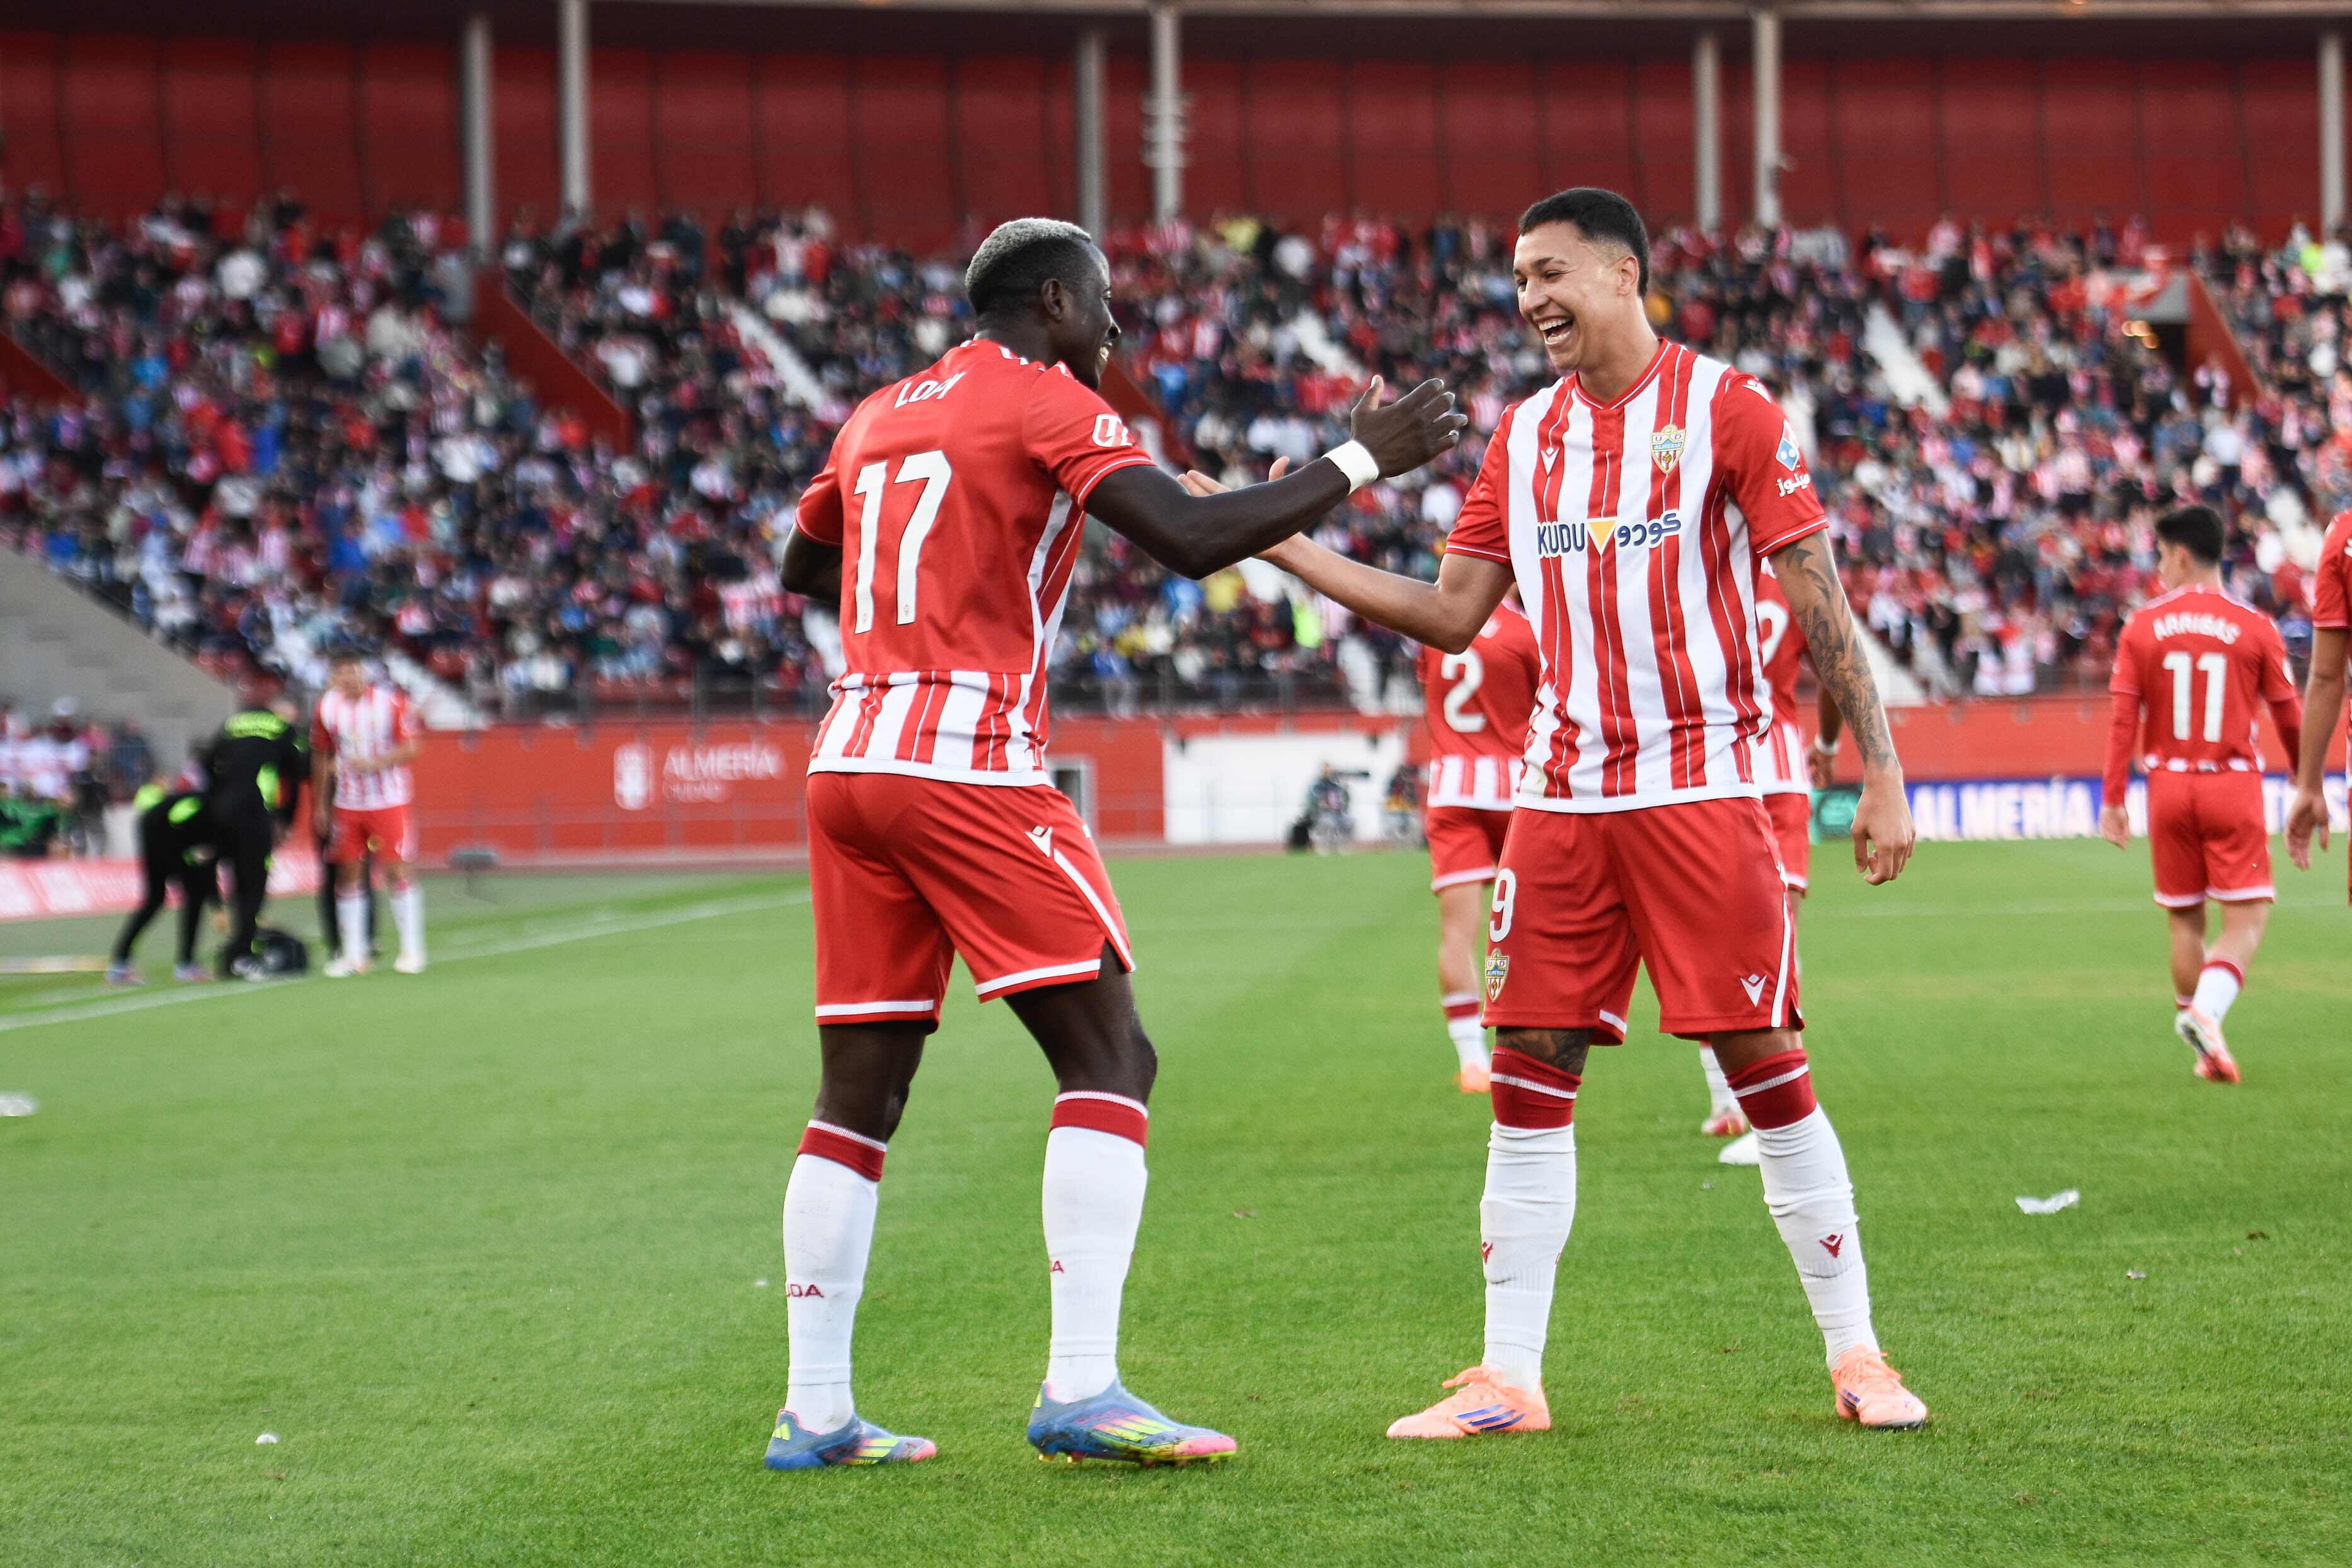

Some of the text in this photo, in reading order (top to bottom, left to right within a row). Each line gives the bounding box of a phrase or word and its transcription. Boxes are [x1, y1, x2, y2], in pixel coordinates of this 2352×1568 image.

[854, 449, 952, 634] 17
[1537, 522, 1585, 555] KUDU
[1617, 512, 1682, 548] كودو
[2153, 612, 2241, 645] ARRIBAS
[1441, 648, 1486, 733] 2
[2162, 651, 2227, 743] 11
[1913, 775, 2096, 841] ALMERÍA
[1489, 868, 1517, 942] 9
